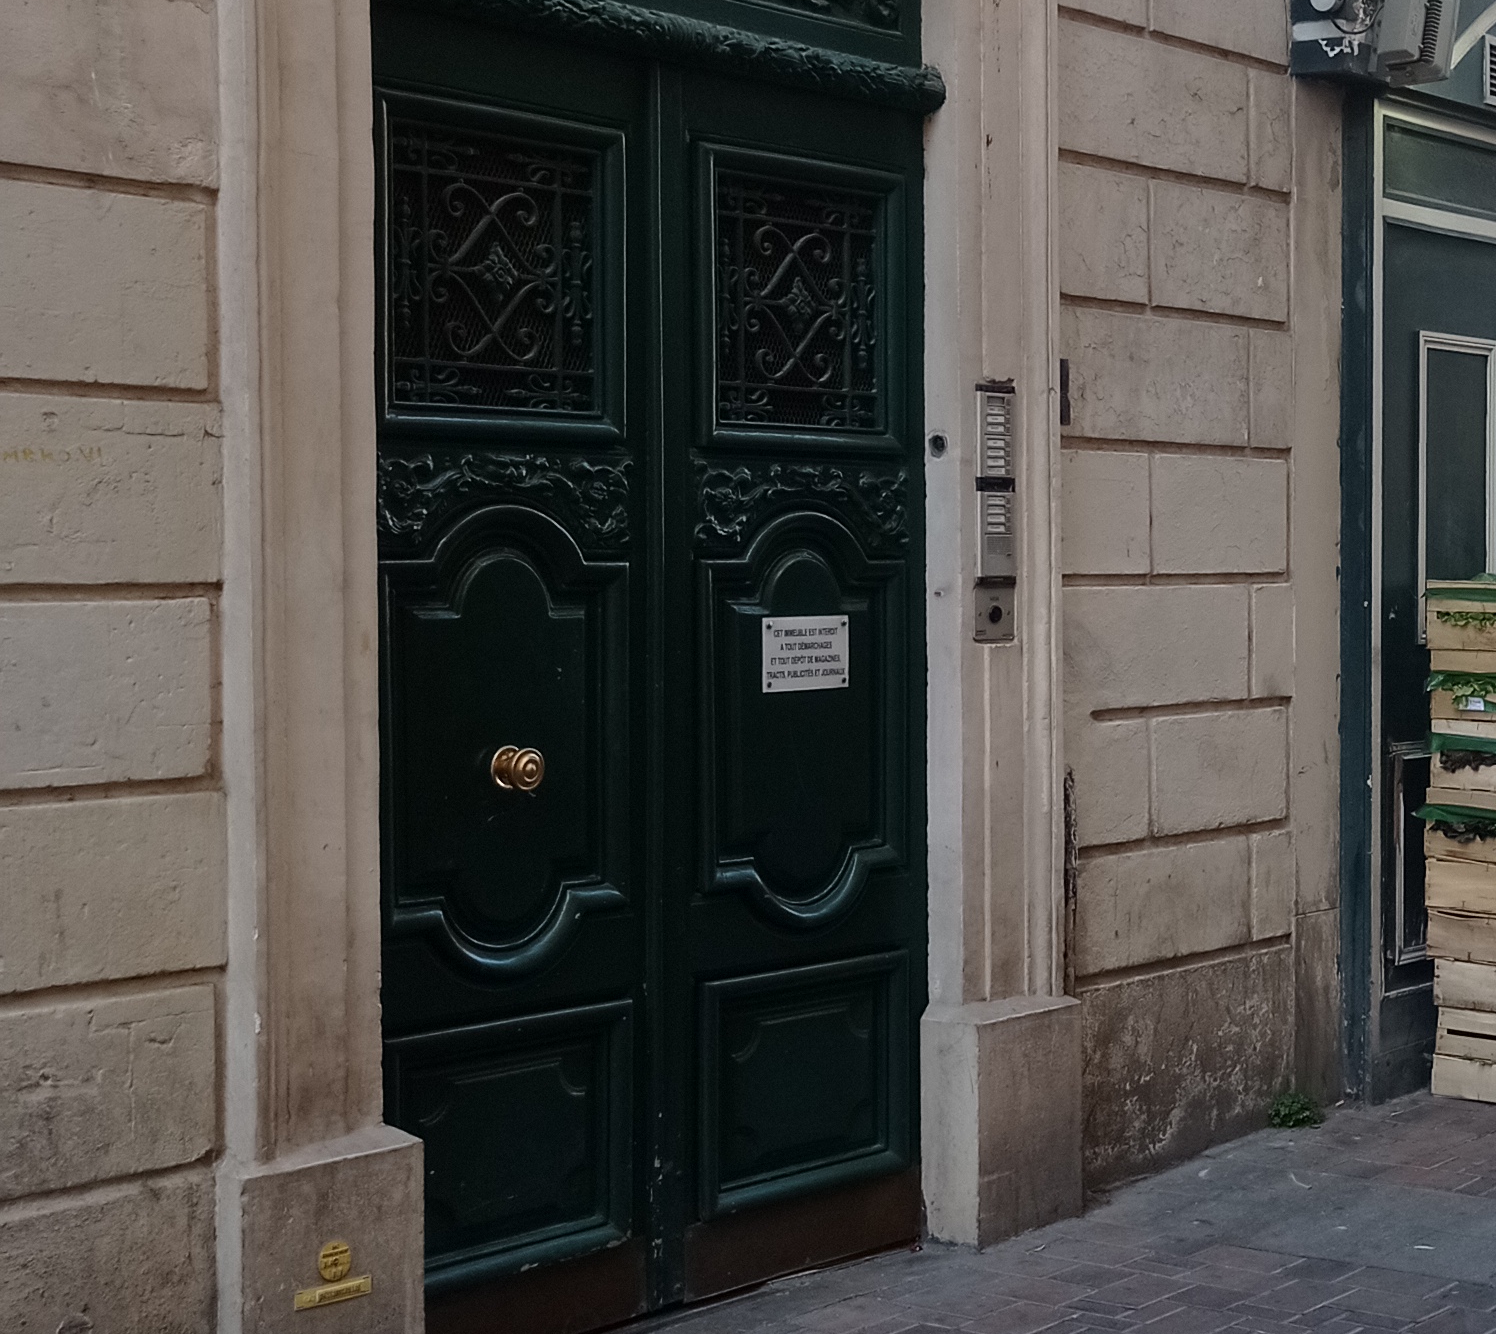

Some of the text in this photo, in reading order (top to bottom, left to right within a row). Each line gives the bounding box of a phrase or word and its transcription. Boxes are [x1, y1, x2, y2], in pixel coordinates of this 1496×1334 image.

[785, 642, 797, 651] TOUT
[771, 657, 776, 665] ET
[778, 656, 790, 665] TOUT
[807, 655, 813, 663] DE
[815, 669, 820, 677] ET
